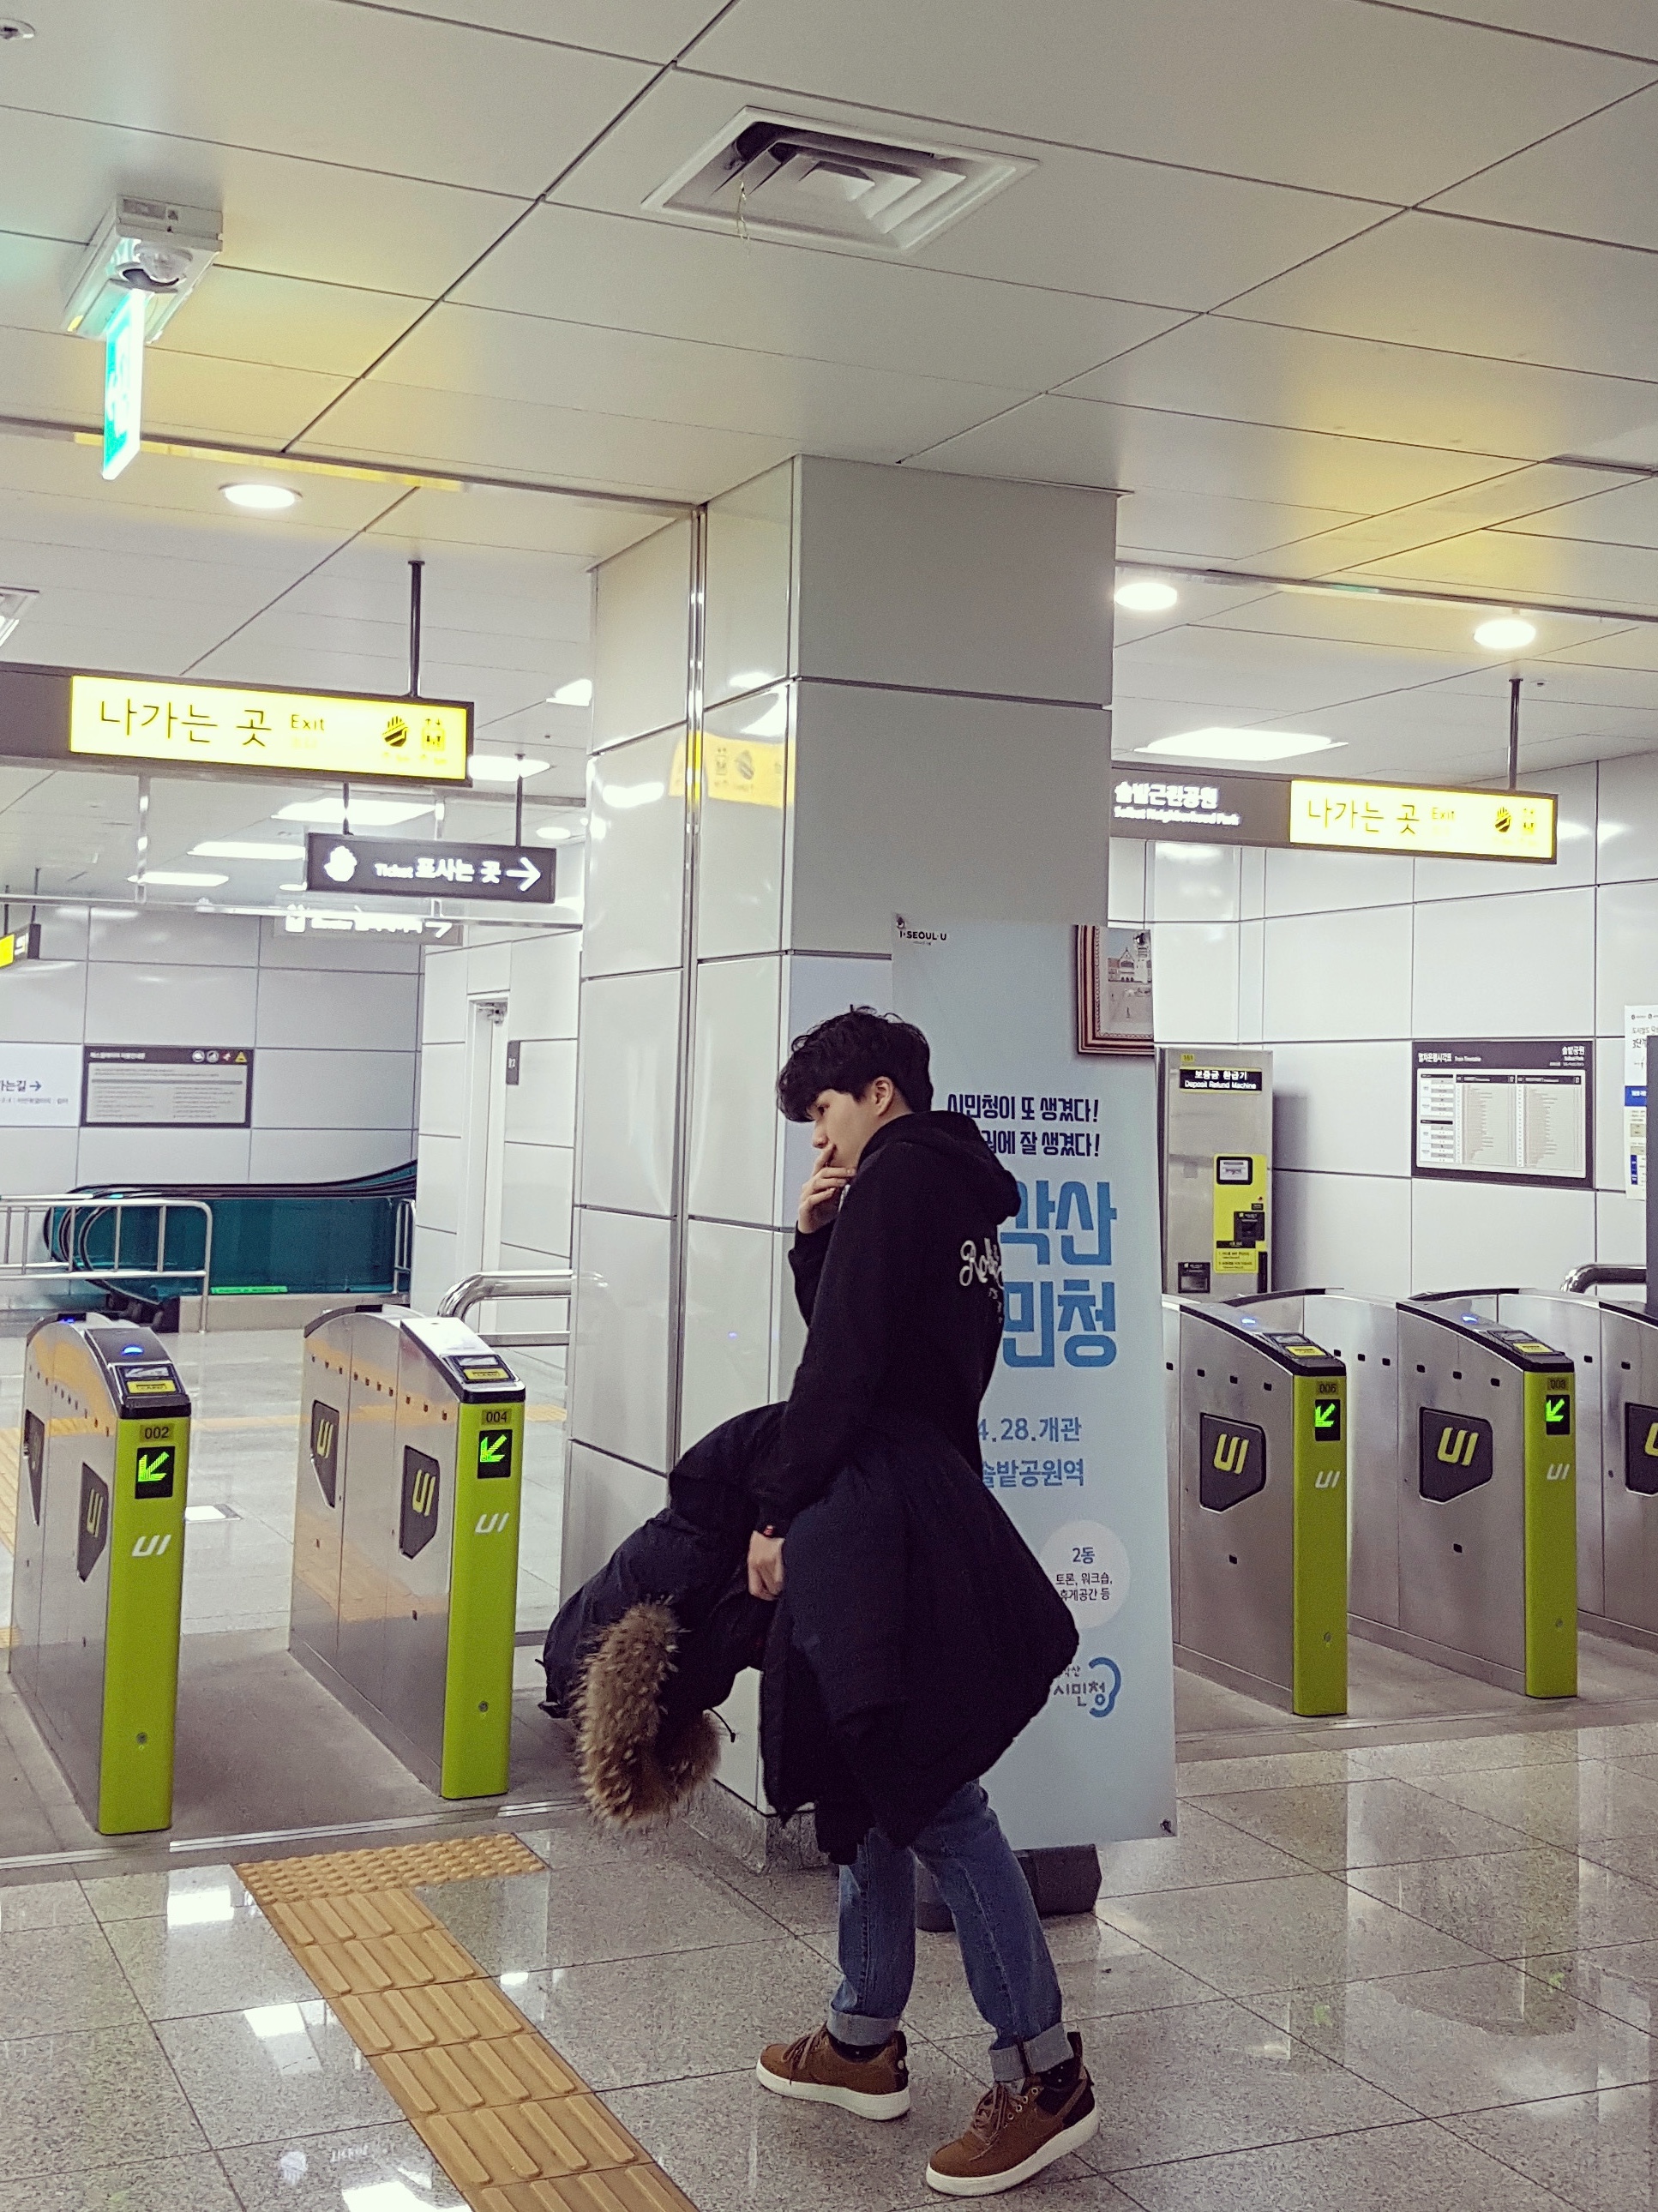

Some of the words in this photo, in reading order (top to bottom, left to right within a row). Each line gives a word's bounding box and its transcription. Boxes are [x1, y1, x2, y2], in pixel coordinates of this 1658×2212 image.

[100, 698, 219, 743] 나가는
[236, 709, 272, 748] 곳
[291, 714, 326, 731] Exit
[1308, 797, 1384, 833] 나가는
[1397, 804, 1420, 834] 곳
[1433, 808, 1455, 820] Exit
[415, 857, 474, 882] 표사는
[480, 861, 502, 884] 곳
[1021, 1097, 1035, 1120] 또
[1040, 1097, 1099, 1123] 생겼다!
[1020, 1131, 1037, 1155] 잘
[1042, 1132, 1100, 1157] 생겼다!
[485, 1410, 508, 1423] 004
[144, 1426, 170, 1440] 002
[1214, 1434, 1250, 1475] UI
[1437, 1427, 1479, 1466] UI
[1314, 1470, 1341, 1488] UI
[1547, 1463, 1571, 1481] UI
[411, 1468, 436, 1518] UI
[87, 1488, 104, 1538] UI
[474, 1512, 510, 1534] UI
[131, 1534, 172, 1557] UI
[1072, 1547, 1096, 1564] 2동
[1100, 1587, 1110, 1601] 등
[1054, 1680, 1106, 1706] 시민청
